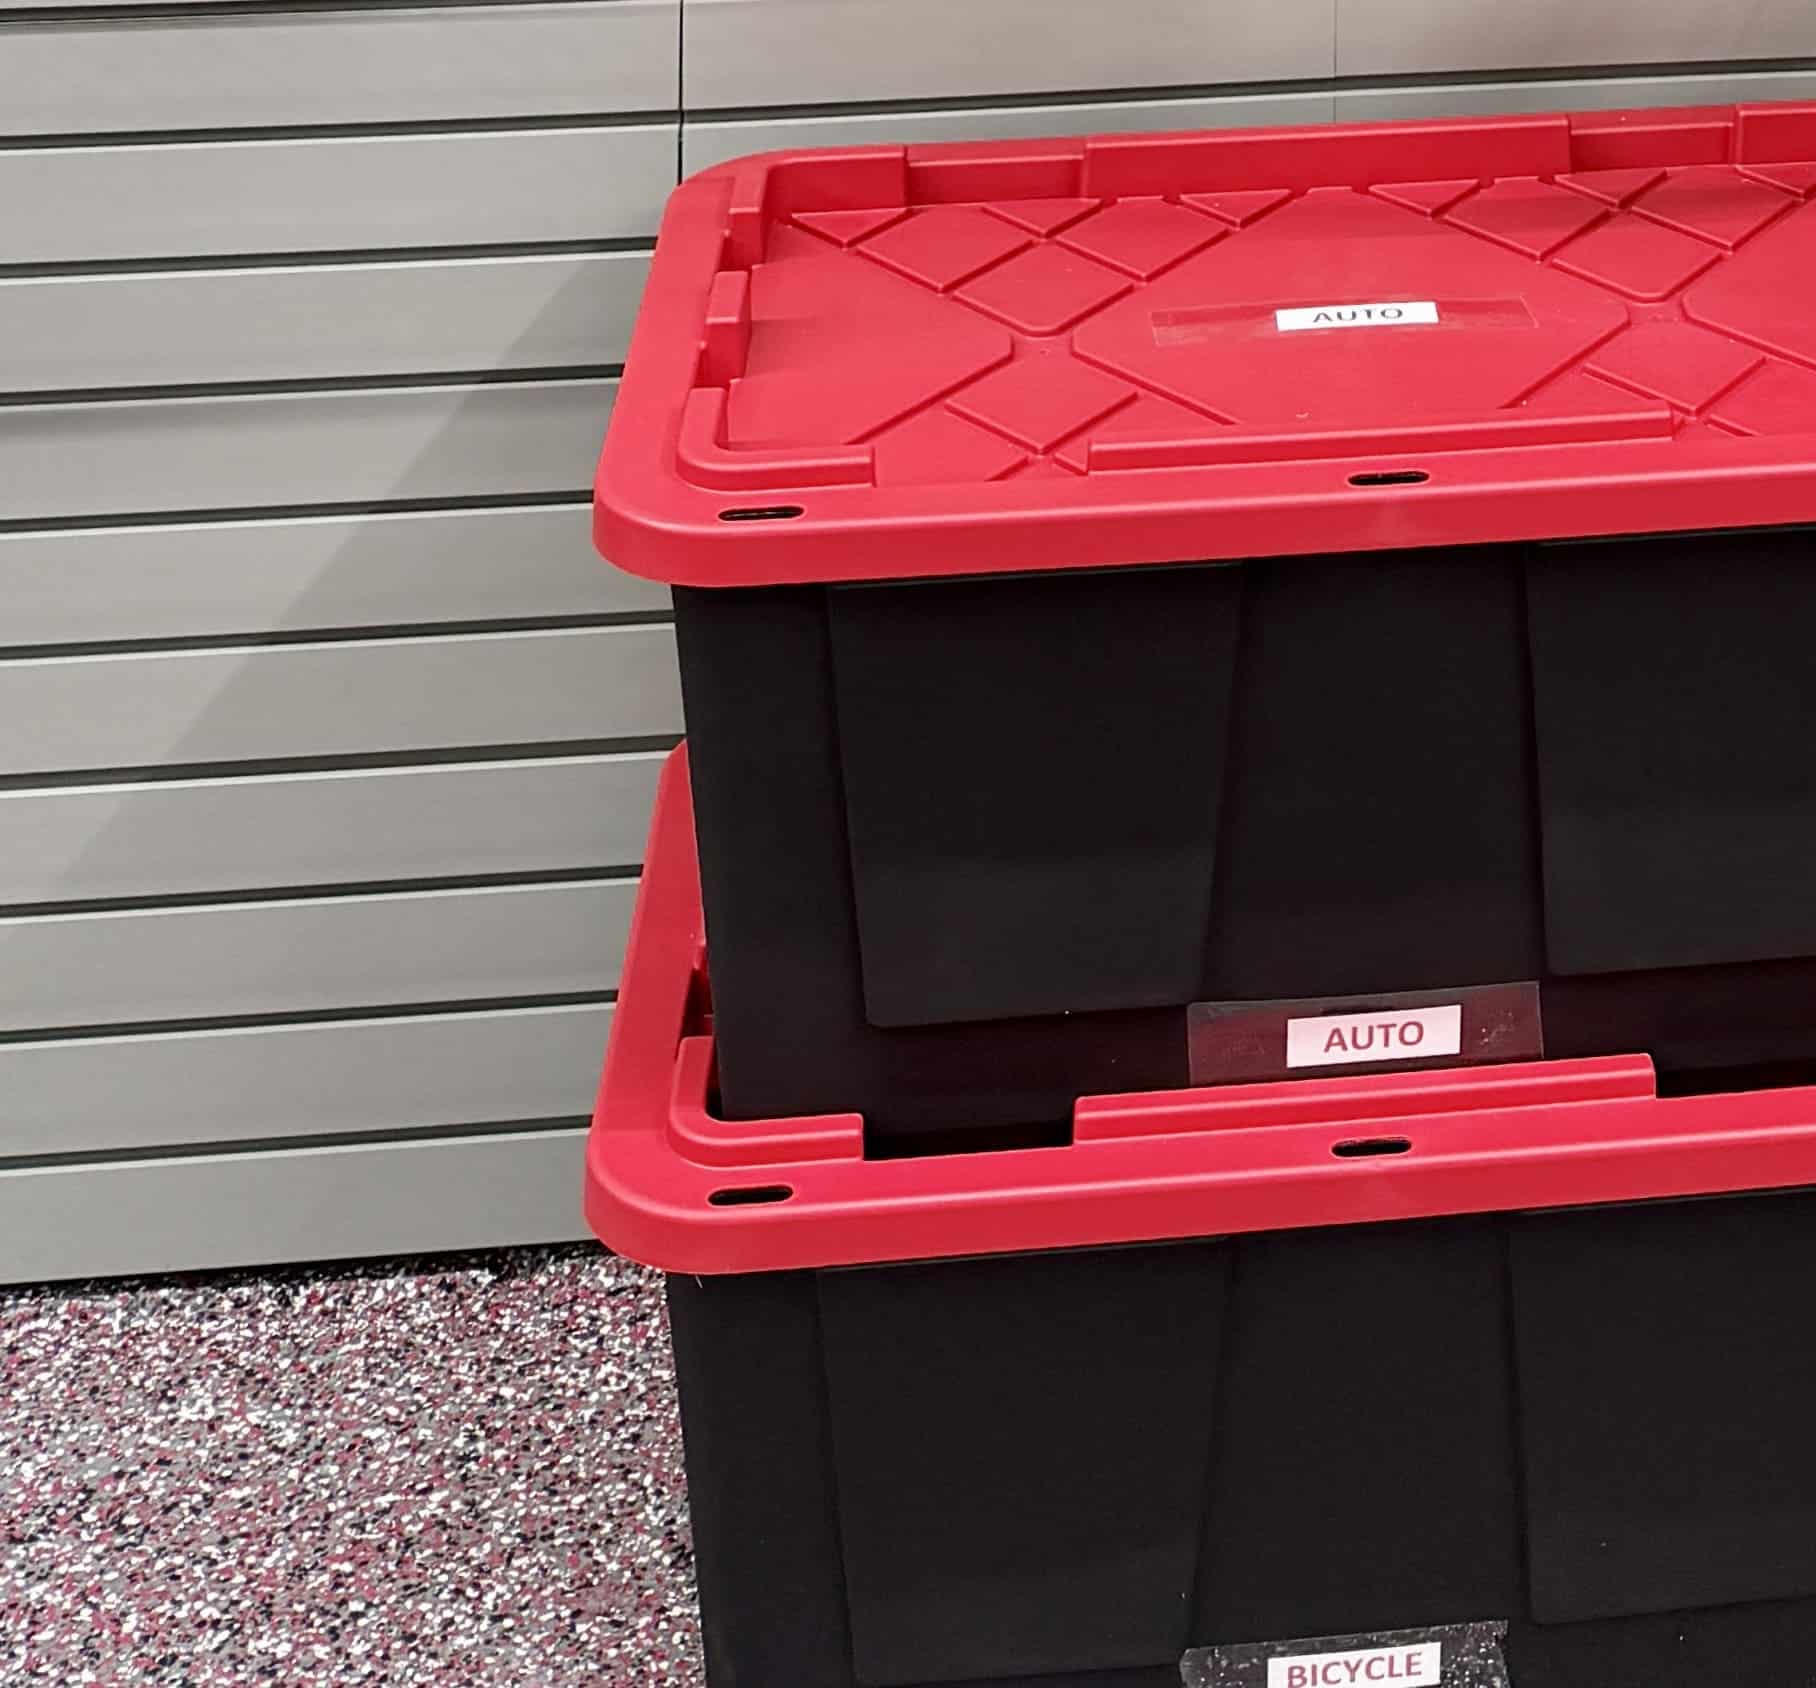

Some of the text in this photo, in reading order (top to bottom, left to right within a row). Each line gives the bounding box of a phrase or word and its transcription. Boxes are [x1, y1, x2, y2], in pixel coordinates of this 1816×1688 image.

[1312, 307, 1404, 323] AUTO
[1323, 1020, 1425, 1054] AUTO
[1286, 1651, 1423, 1688] BICYCLE
